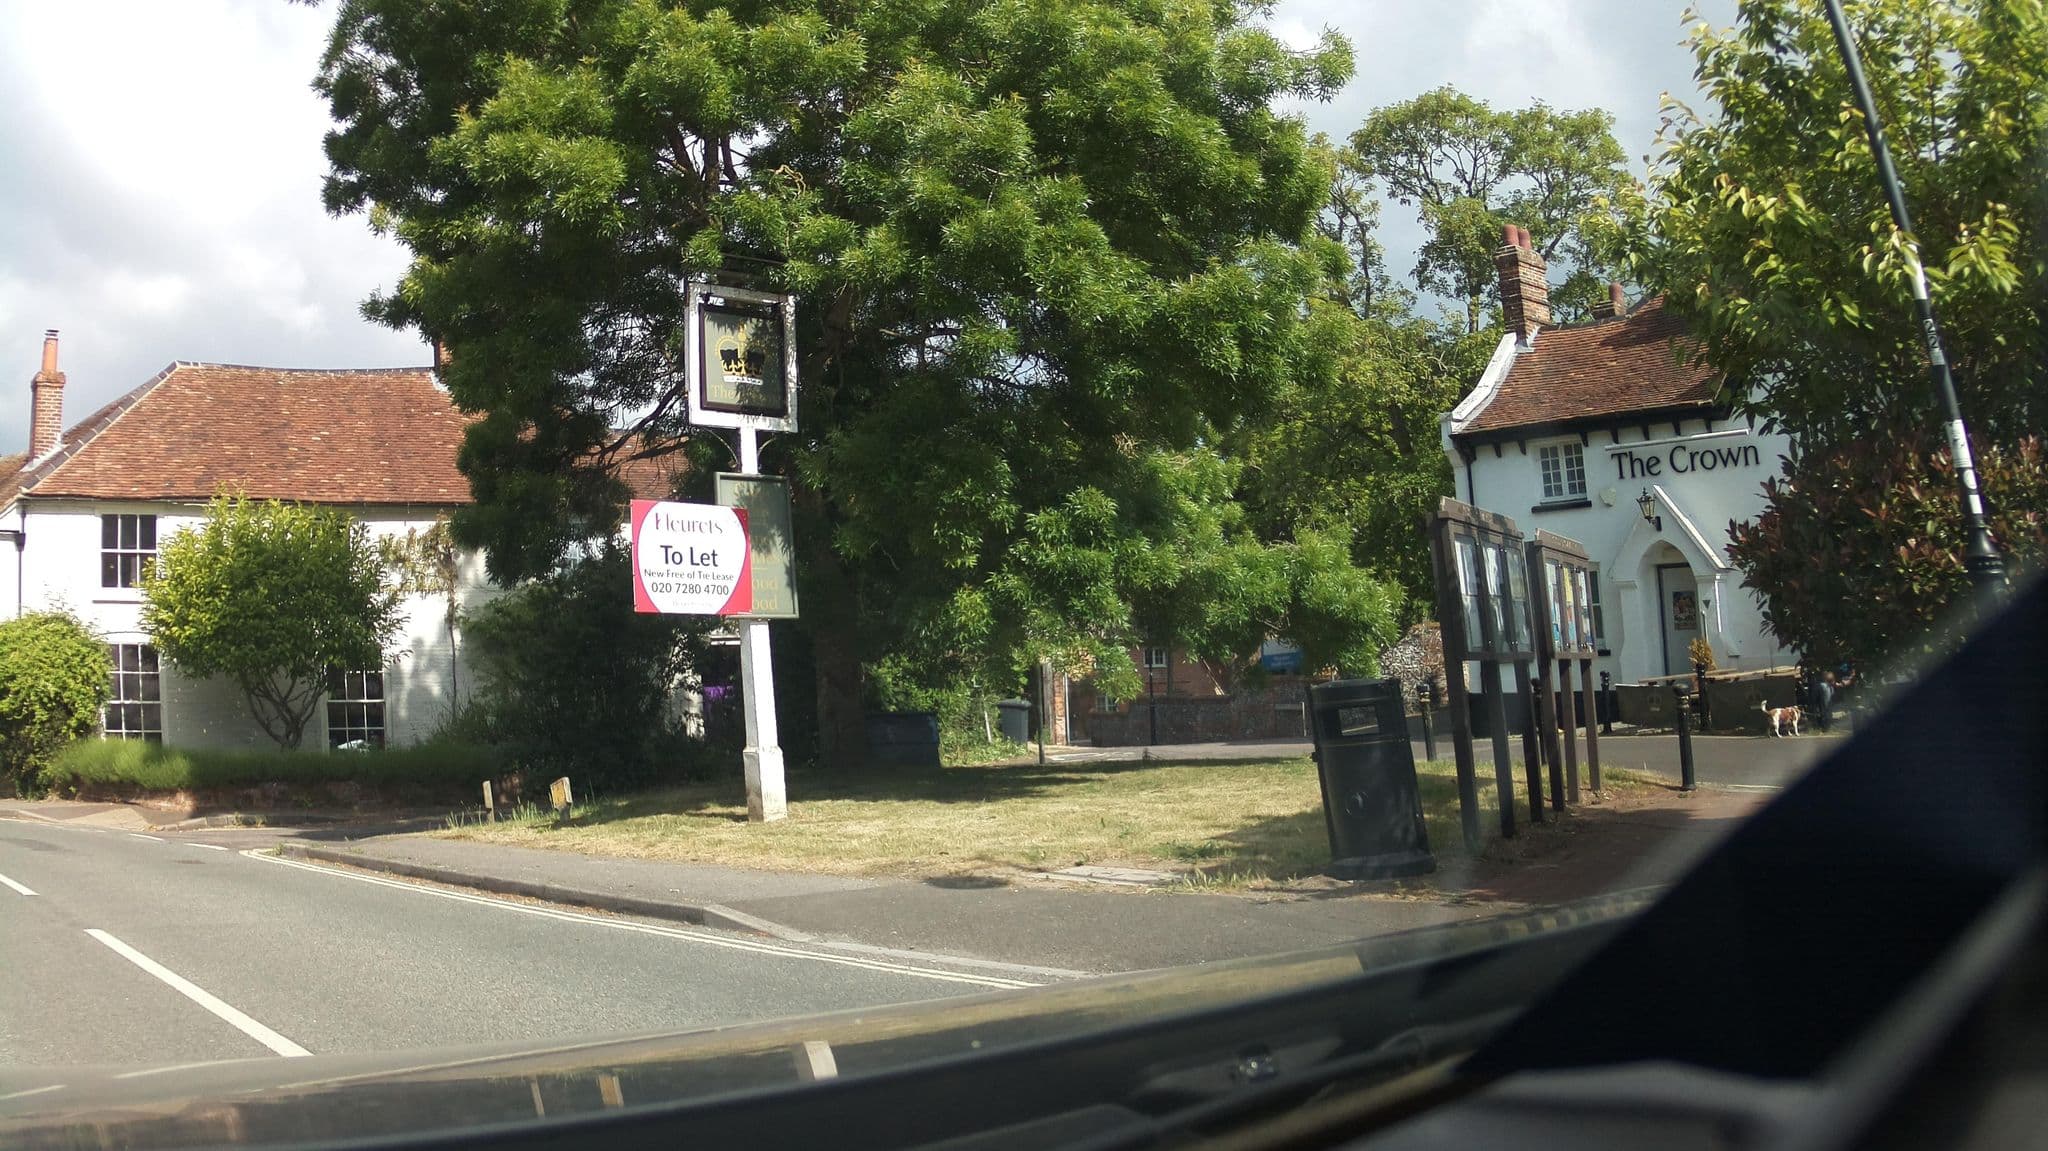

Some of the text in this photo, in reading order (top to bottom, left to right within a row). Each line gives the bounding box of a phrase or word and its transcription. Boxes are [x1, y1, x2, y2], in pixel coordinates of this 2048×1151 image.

[1611, 444, 1761, 480] The Crown
[660, 545, 719, 567] To Let
[644, 568, 734, 581] New Free of Tie Lease
[651, 582, 729, 596] 020 7280 4700
[752, 598, 778, 610] ood
